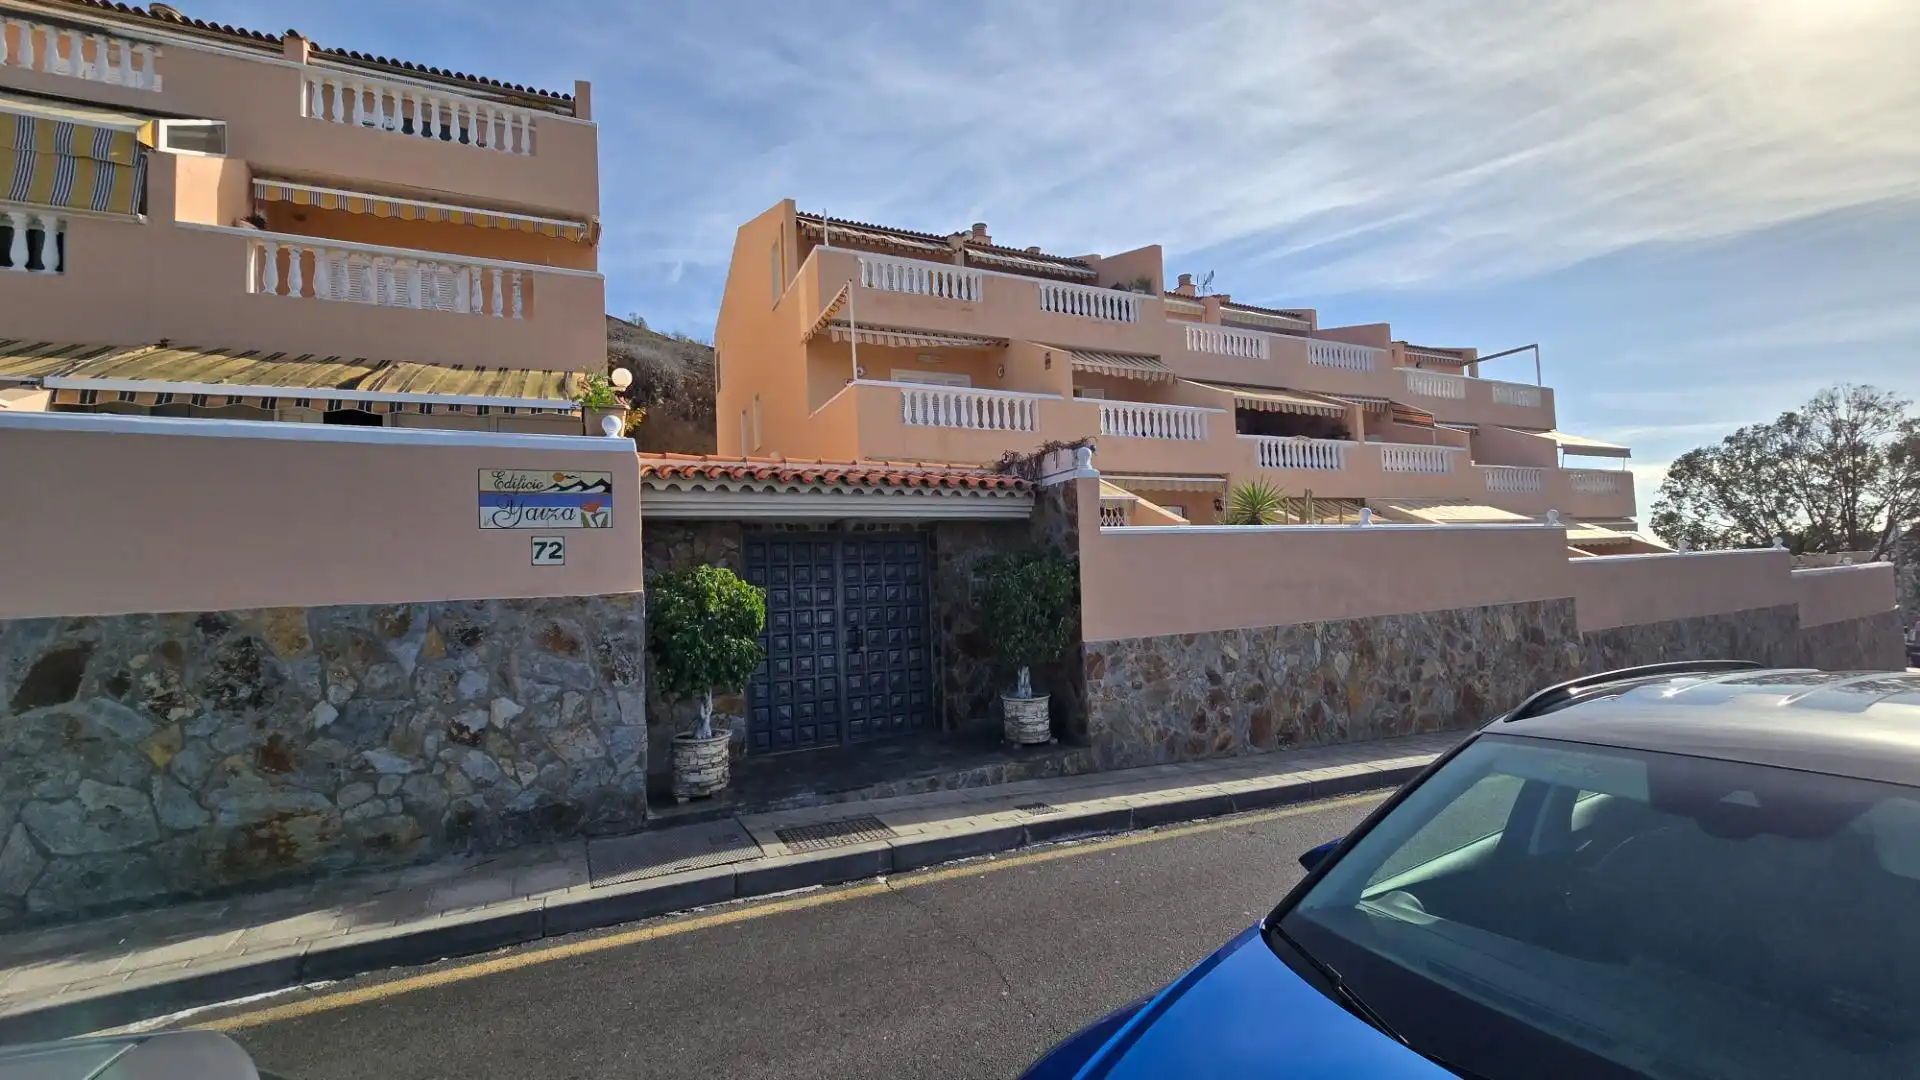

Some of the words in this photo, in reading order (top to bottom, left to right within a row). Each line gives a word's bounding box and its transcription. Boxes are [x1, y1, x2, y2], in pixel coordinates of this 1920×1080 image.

[491, 471, 544, 493] Edificio
[492, 495, 576, 528] Yaiza
[533, 541, 563, 560] 72
